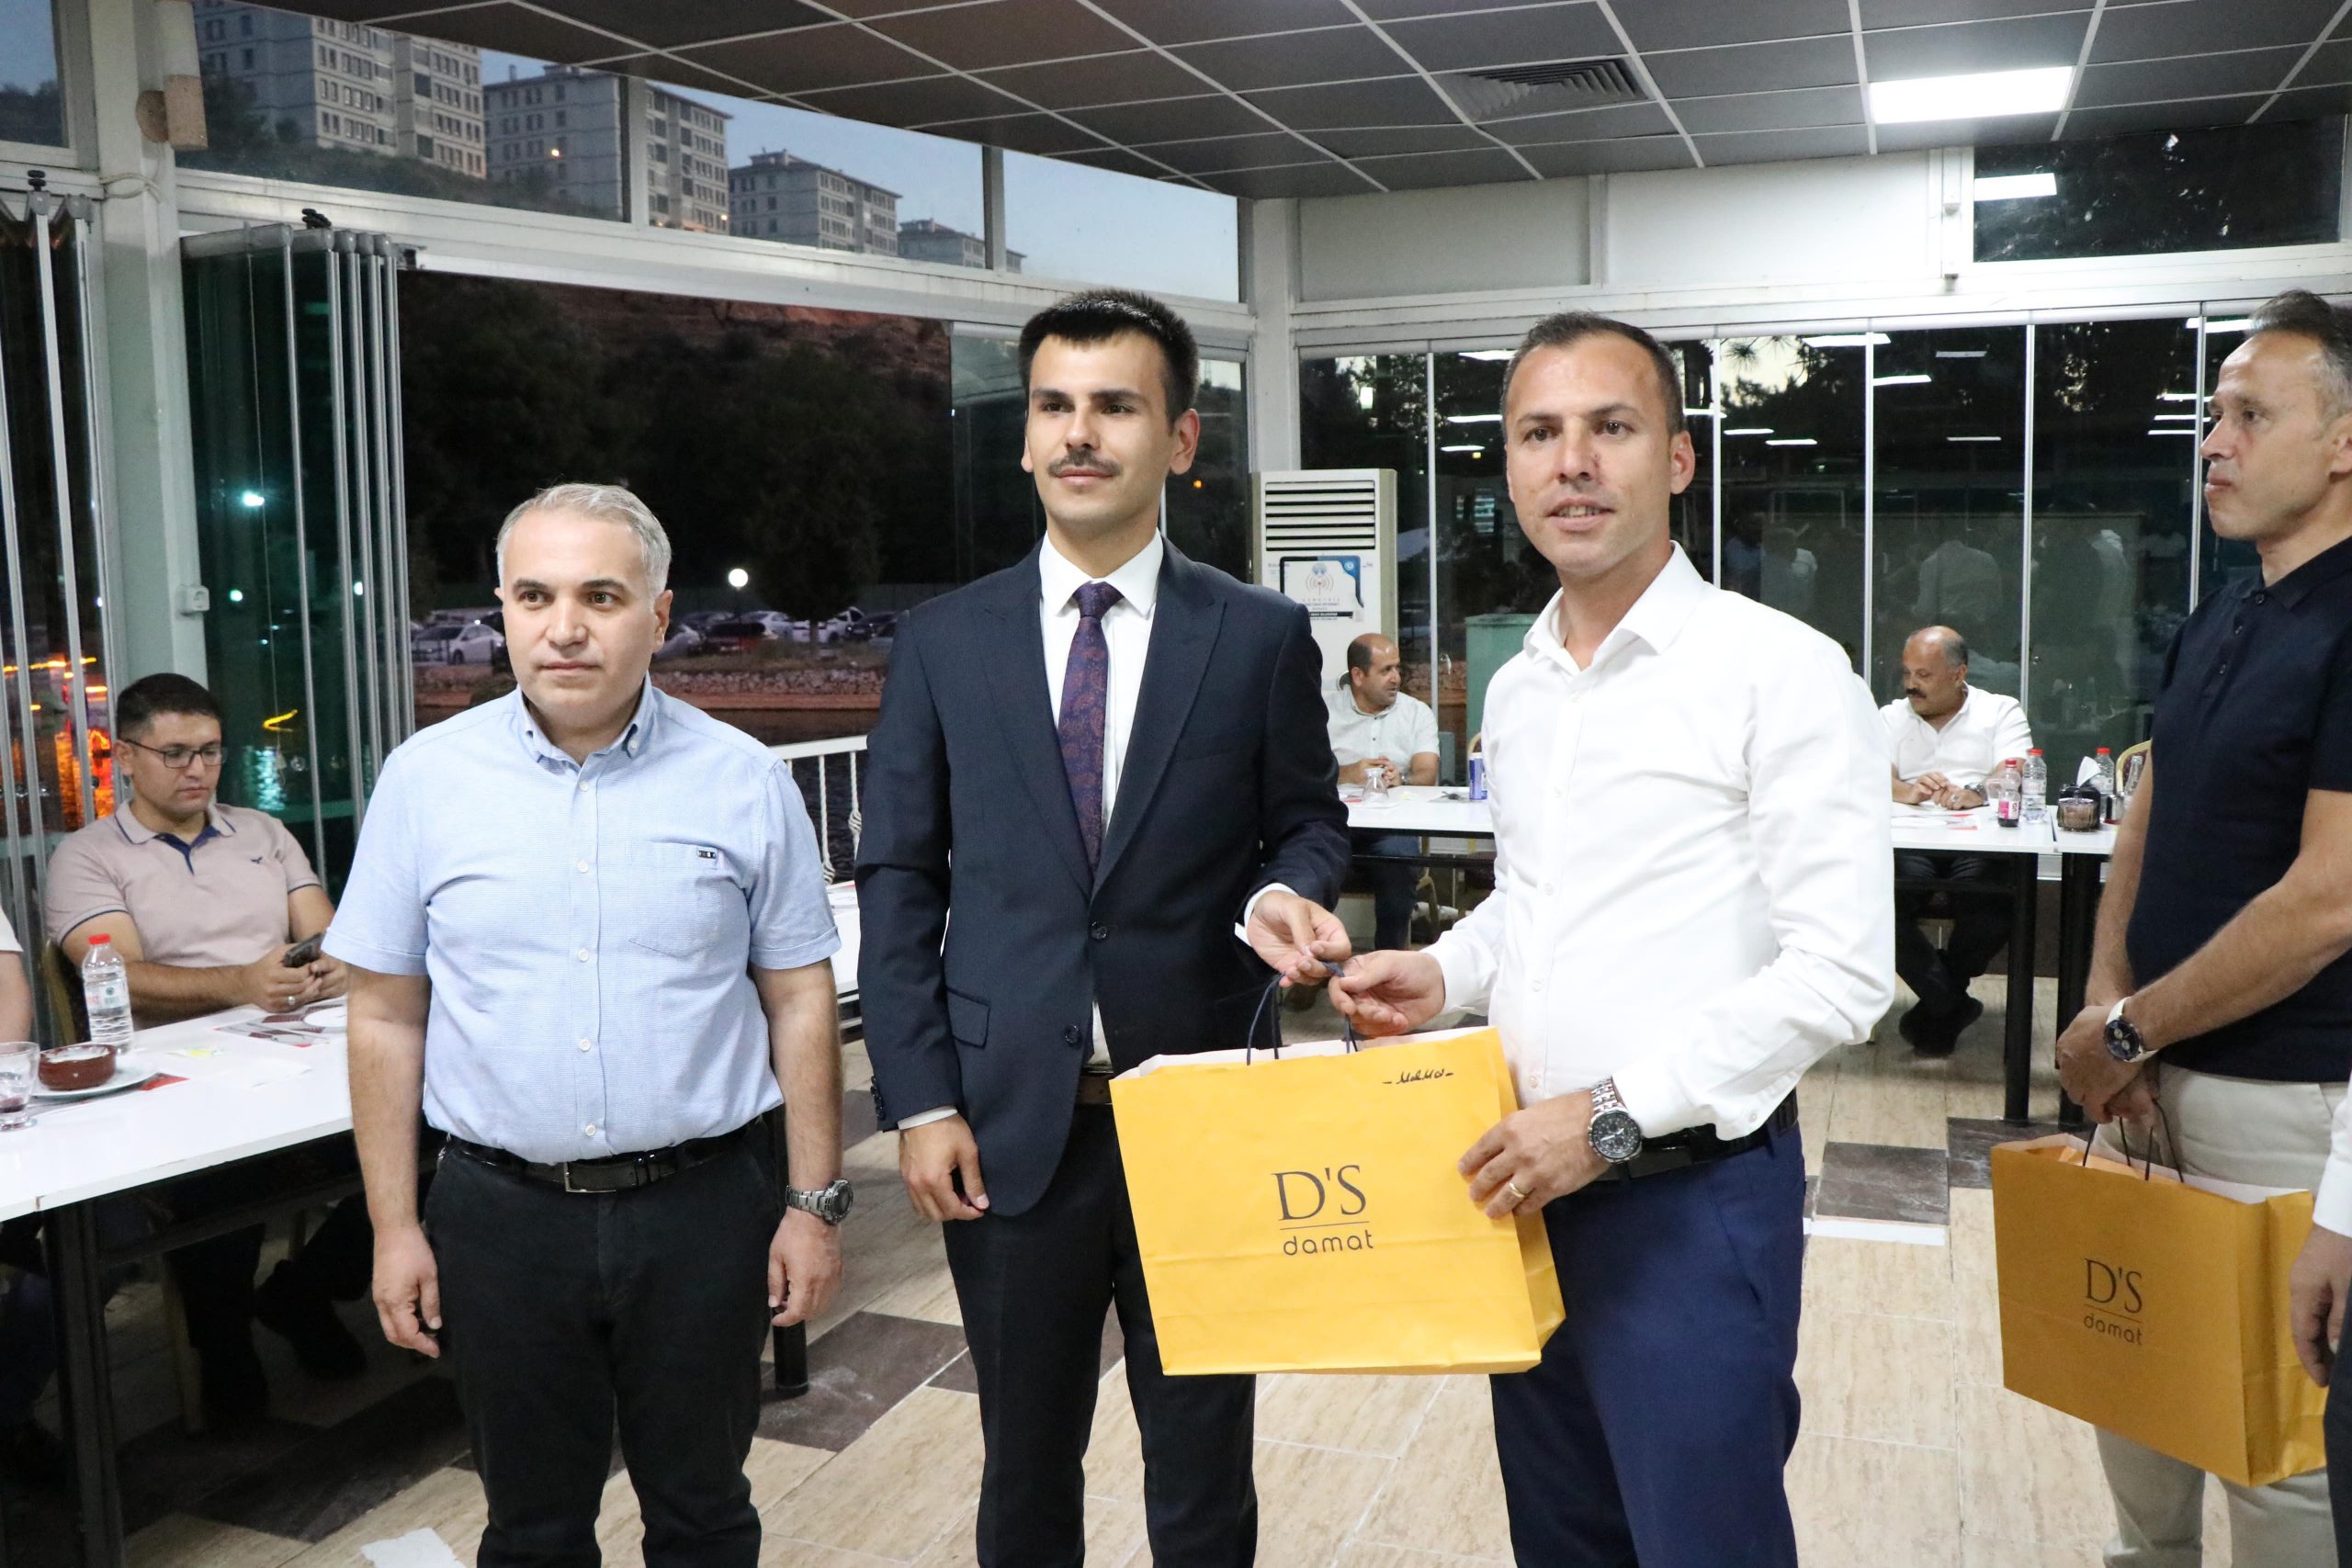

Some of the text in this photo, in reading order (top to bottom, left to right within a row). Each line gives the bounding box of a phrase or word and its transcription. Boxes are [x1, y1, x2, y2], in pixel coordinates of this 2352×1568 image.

[1271, 1164, 1366, 1221] D'S
[1283, 1229, 1374, 1256] damat
[2083, 1257, 2143, 1314] D'S
[2083, 1313, 2143, 1346] damat
